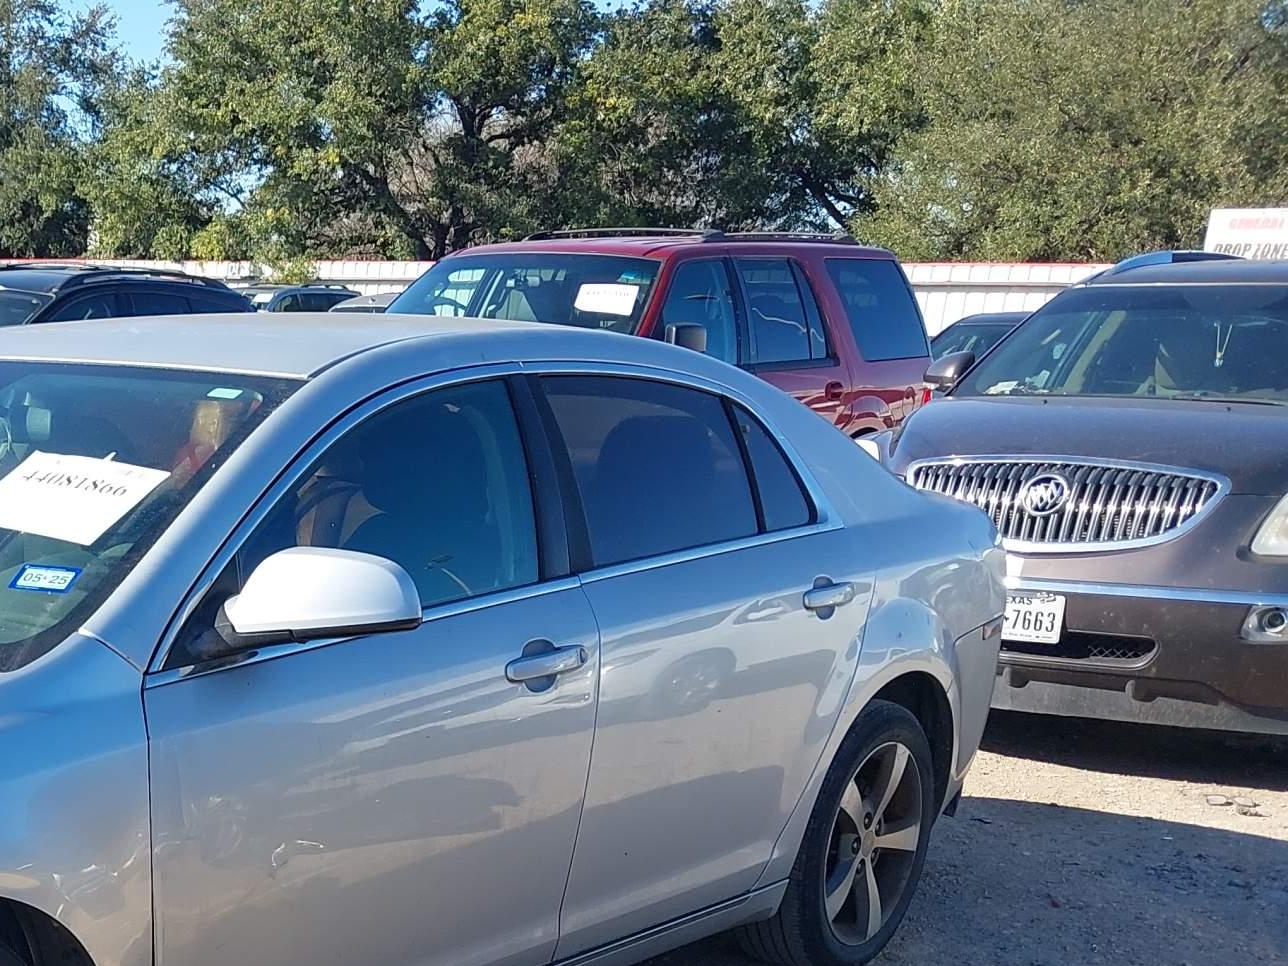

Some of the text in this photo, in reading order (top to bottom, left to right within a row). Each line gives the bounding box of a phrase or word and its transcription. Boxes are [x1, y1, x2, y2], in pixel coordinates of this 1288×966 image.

[1214, 243, 1288, 259] DROP ZONE
[22, 470, 128, 497] 44081866
[23, 572, 69, 585] 05 25
[1011, 609, 1056, 633] 7663
